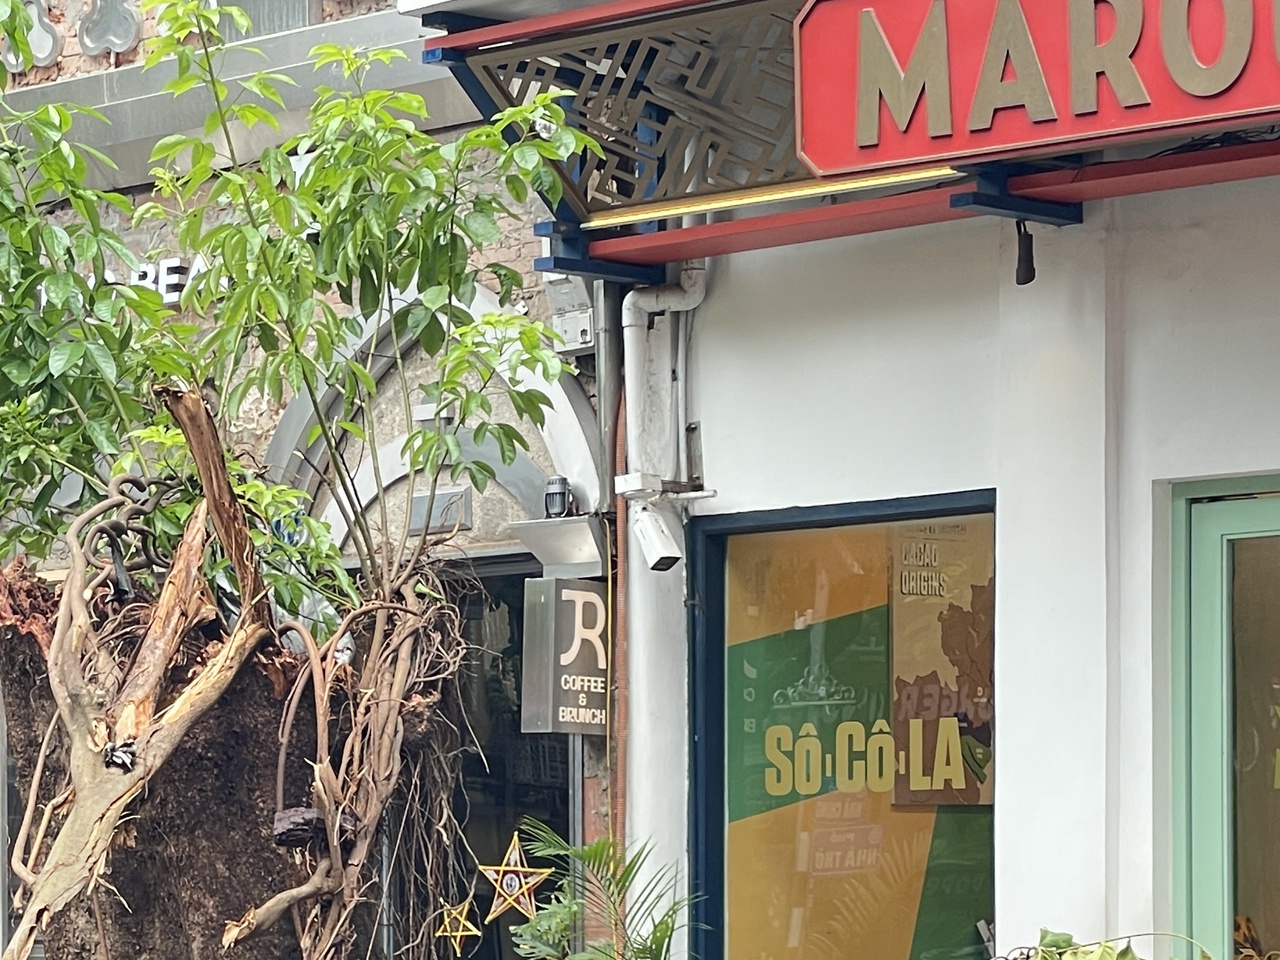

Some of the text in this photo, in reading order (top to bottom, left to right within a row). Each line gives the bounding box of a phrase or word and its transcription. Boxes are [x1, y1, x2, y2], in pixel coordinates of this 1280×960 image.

[857, 0, 1280, 147] MARO
[900, 570, 950, 597] ORIGINS
[560, 674, 606, 693] COFFEE
[578, 693, 587, 706] &
[558, 706, 606, 725] BRUNCH
